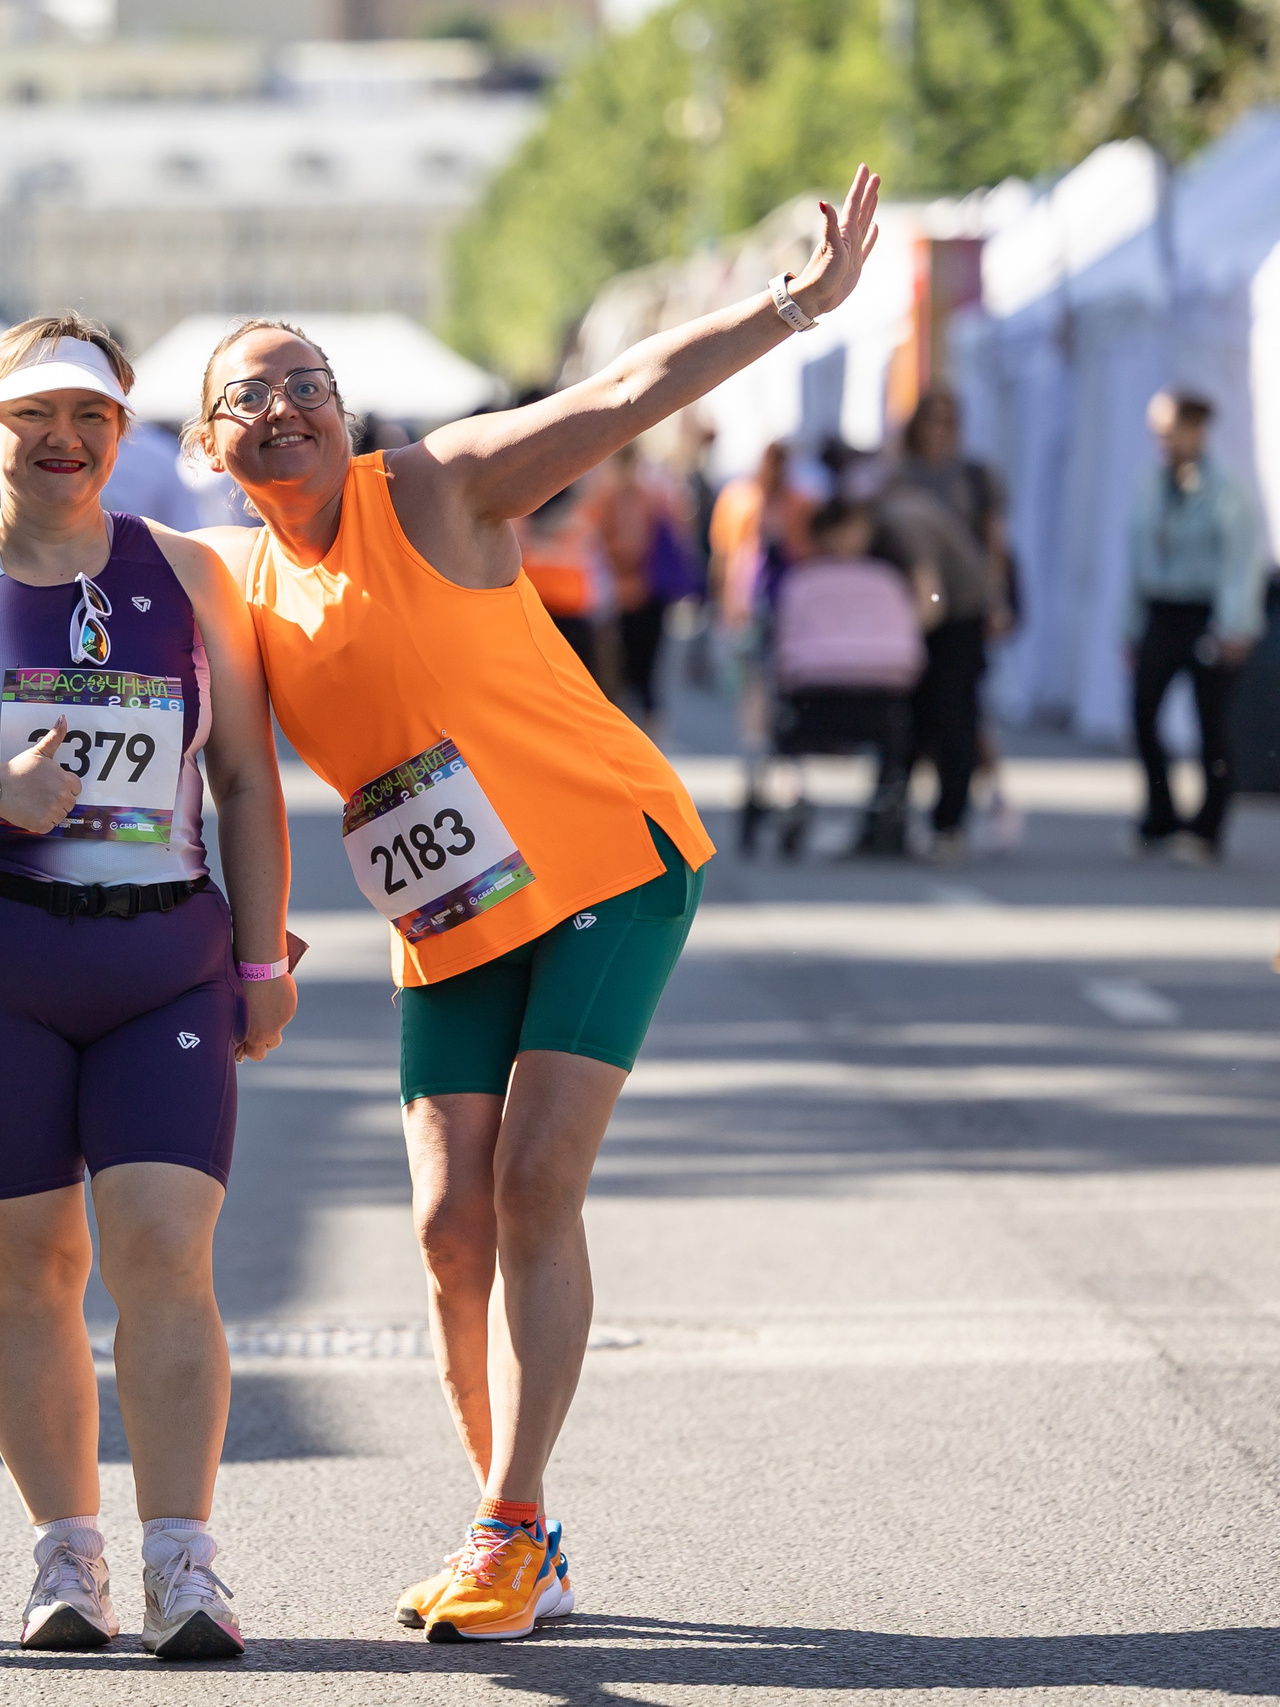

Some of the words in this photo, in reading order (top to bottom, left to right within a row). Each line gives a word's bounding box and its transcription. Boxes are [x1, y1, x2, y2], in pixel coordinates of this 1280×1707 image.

[20, 672, 168, 698] КРАСОЧНЫЙ
[20, 694, 99, 703] ЗАБЕГ
[108, 695, 181, 712] 2026
[401, 760, 464, 801] 2026
[370, 808, 476, 896] 2183
